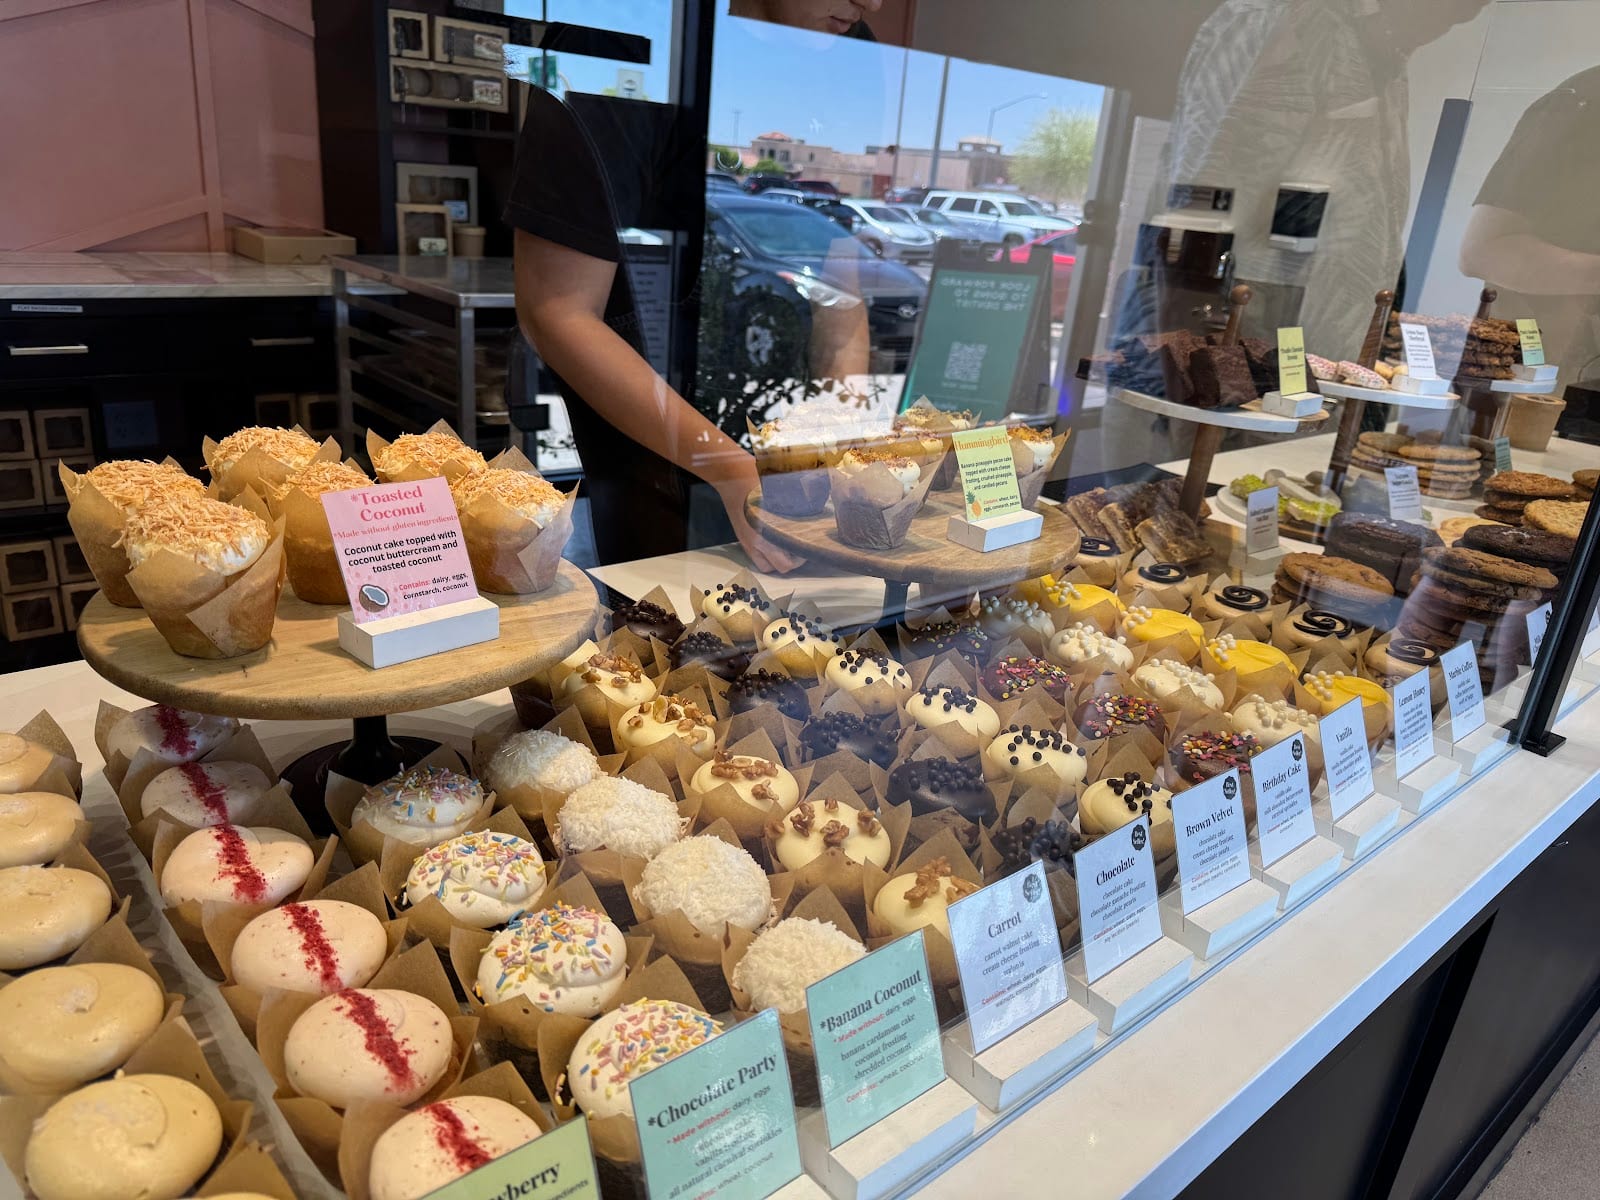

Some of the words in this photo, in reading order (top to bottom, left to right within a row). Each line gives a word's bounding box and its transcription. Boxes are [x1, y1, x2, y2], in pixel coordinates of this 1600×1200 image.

[360, 502, 425, 522] Coconut
[361, 524, 390, 535] without
[392, 520, 416, 533] gluten
[417, 514, 457, 528] ingredients
[344, 543, 382, 556] Coconut
[384, 539, 404, 550] cake
[406, 533, 437, 547] topped
[438, 530, 457, 541] with
[348, 553, 386, 567] coconut
[386, 544, 441, 560] buttercream
[442, 540, 458, 551] and
[372, 560, 406, 574] toasted
[408, 554, 442, 567] coconut
[403, 588, 442, 600] cornstarch,
[443, 582, 469, 592] coconut
[432, 574, 451, 585] dairy,
[1262, 772, 1287, 793] Birthday
[1287, 763, 1301, 778] Cake
[1186, 818, 1211, 837] Brown
[1211, 805, 1234, 823] Velvet
[1096, 856, 1136, 886] Chocolate
[1090, 901, 1111, 918] chocolate
[988, 911, 1022, 938] Carrot
[982, 962, 1000, 976] cream
[1001, 952, 1019, 966] cheese
[984, 948, 1002, 962] carrot
[874, 969, 922, 1005] Coconut
[838, 1028, 857, 1043] Made
[841, 1043, 866, 1061] banana
[867, 1025, 900, 1047] cardamom
[901, 1013, 915, 1026] cake
[854, 1048, 881, 1067] coconut
[882, 1032, 908, 1051] frosting
[854, 1058, 886, 1080] shredded
[886, 1042, 912, 1061] coconut
[737, 1054, 777, 1085] Party
[672, 1127, 696, 1144] Made
[669, 1186, 680, 1200] all
[682, 1167, 713, 1191] natural
[714, 1147, 747, 1172] carnival
[747, 1127, 783, 1153] sprinkles
[489, 1163, 560, 1200] berry
